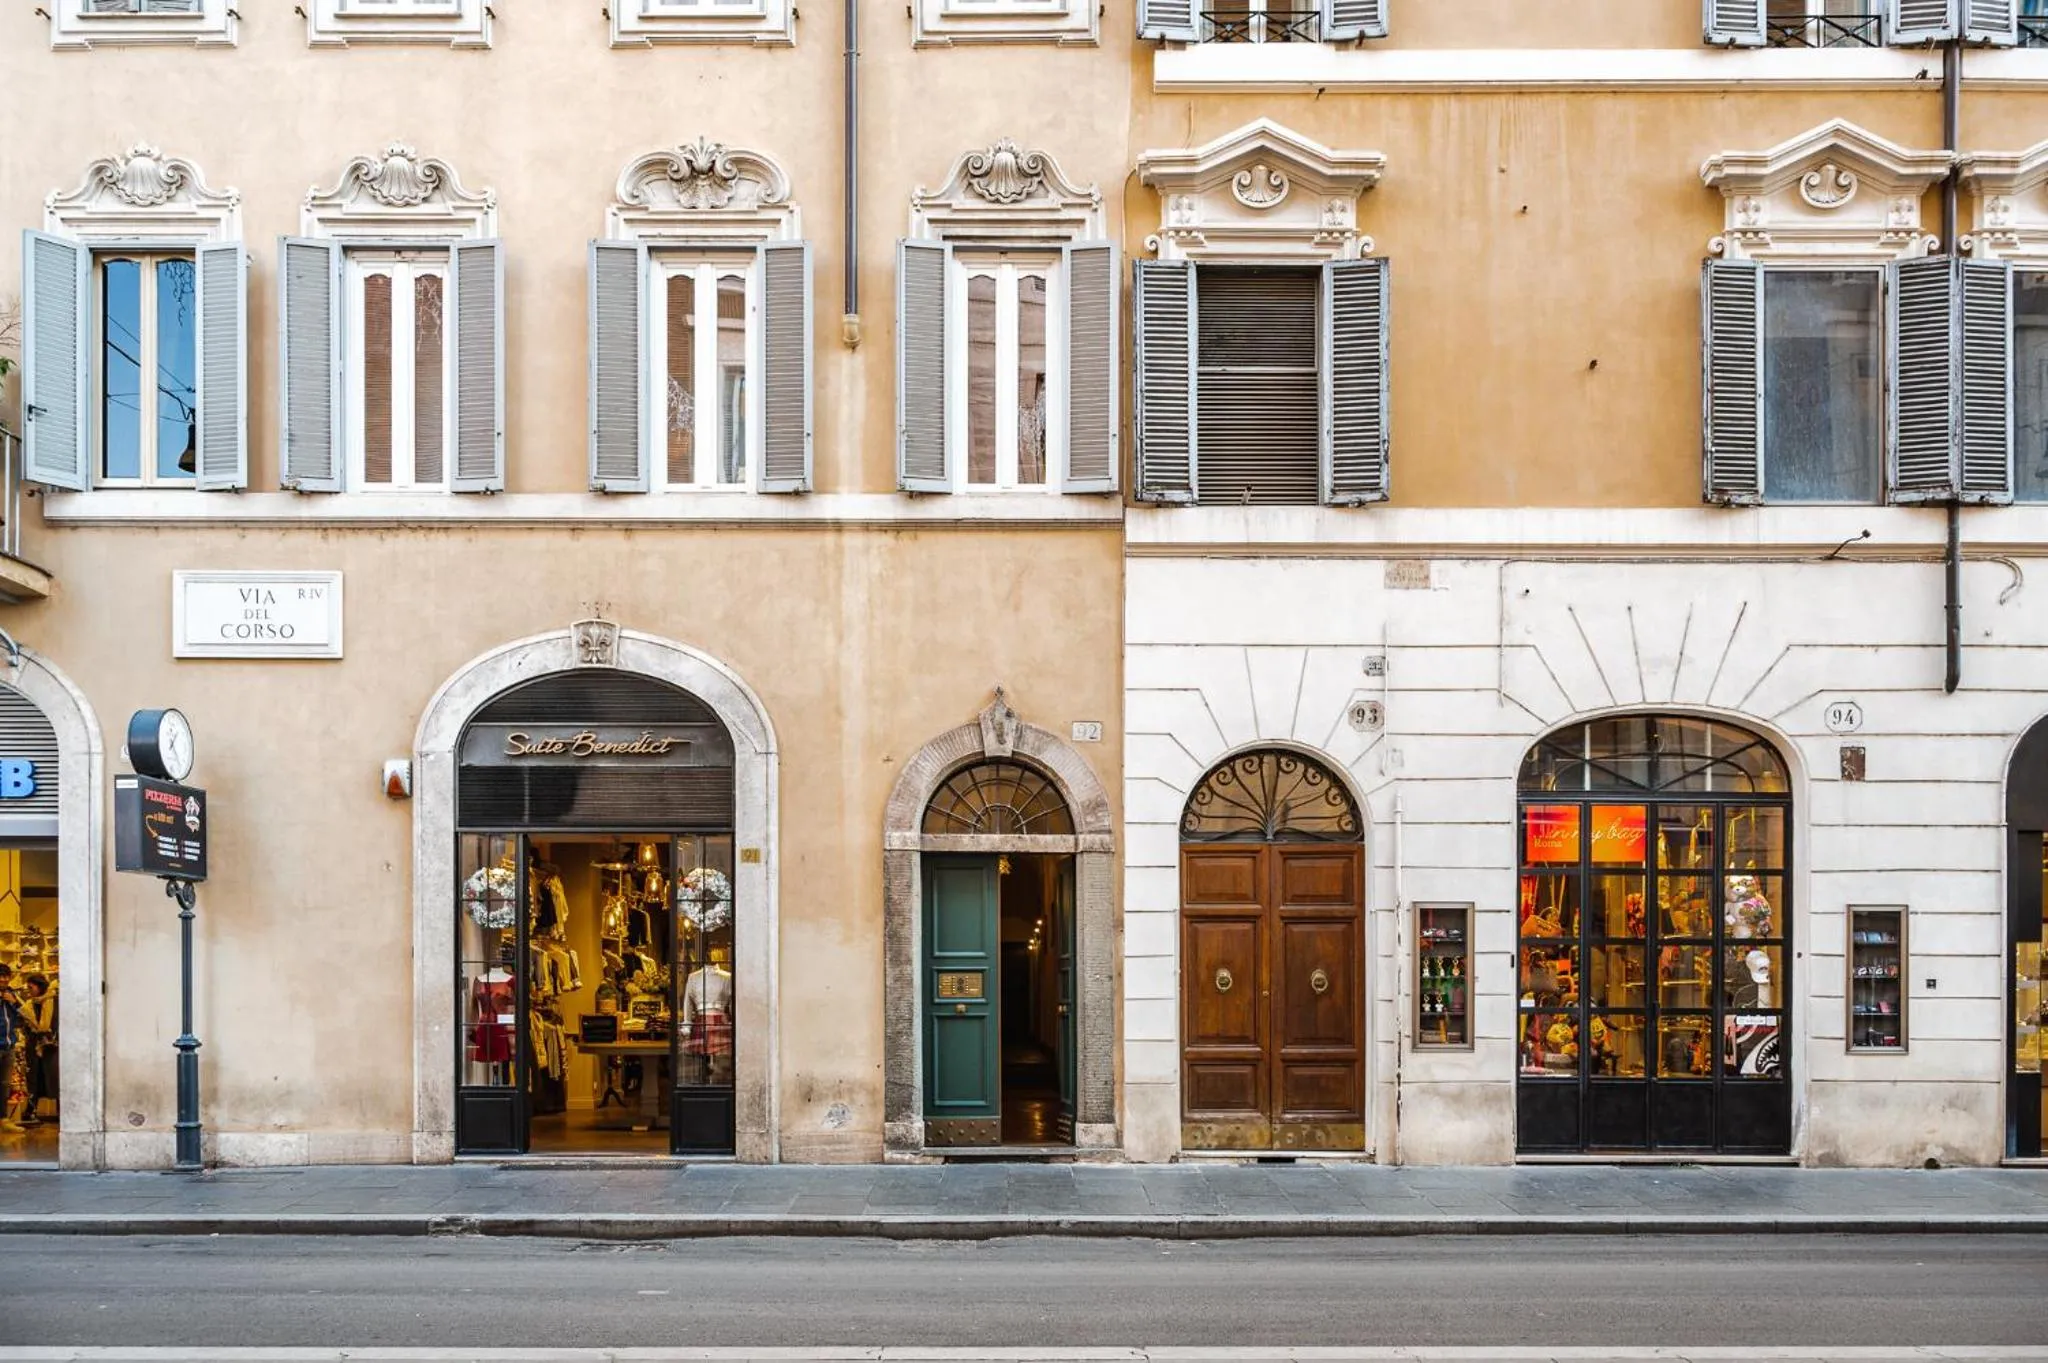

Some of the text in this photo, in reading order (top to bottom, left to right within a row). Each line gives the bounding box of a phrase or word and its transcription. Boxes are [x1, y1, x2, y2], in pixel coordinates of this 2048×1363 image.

[239, 588, 276, 605] VIA
[243, 608, 271, 620] DEL
[220, 623, 296, 639] CORSO
[1356, 708, 1377, 724] 93
[1833, 710, 1853, 725] 94
[504, 729, 697, 757] Suite Benedict
[145, 789, 182, 806] PIZZERIA
[1607, 817, 1644, 846] bag
[1534, 838, 1563, 848] Roma
